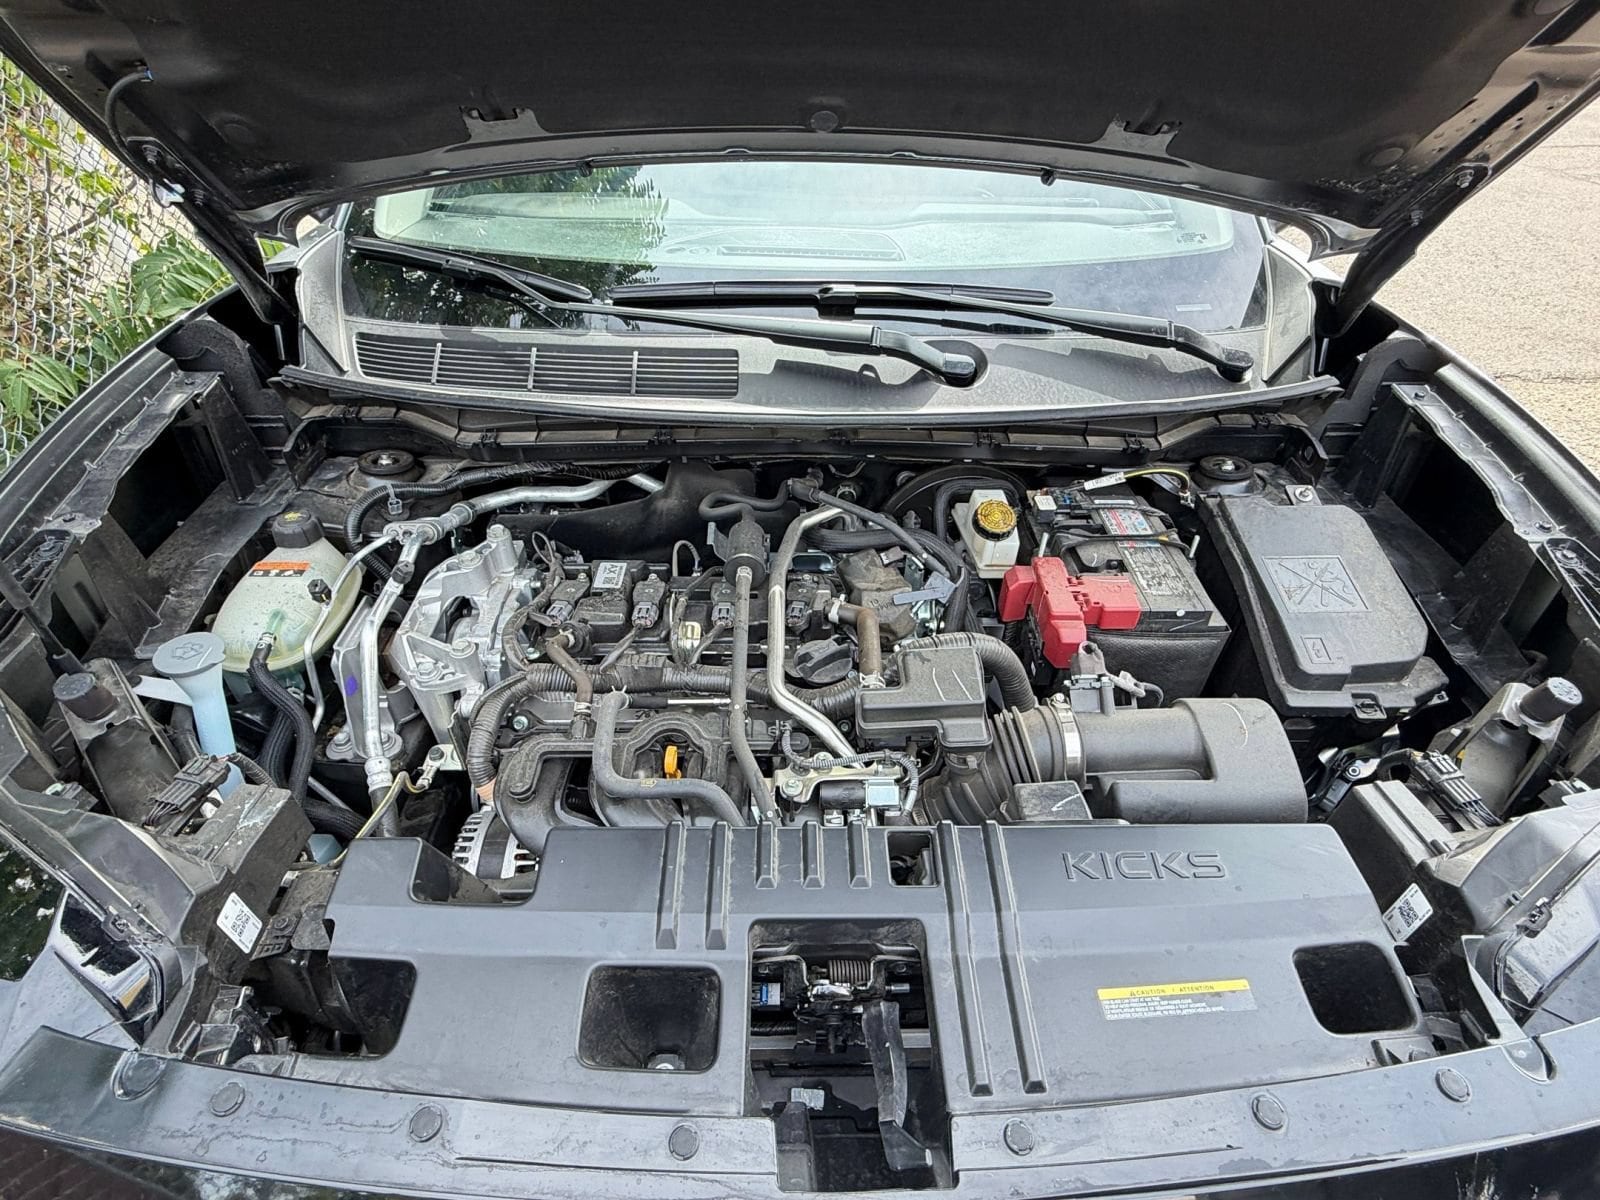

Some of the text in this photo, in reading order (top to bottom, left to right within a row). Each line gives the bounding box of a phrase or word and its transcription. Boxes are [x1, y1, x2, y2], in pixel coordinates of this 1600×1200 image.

[1062, 850, 1226, 880] KICKS
[1136, 988, 1166, 996] CAUTION
[1179, 985, 1215, 993] ATTENTION
